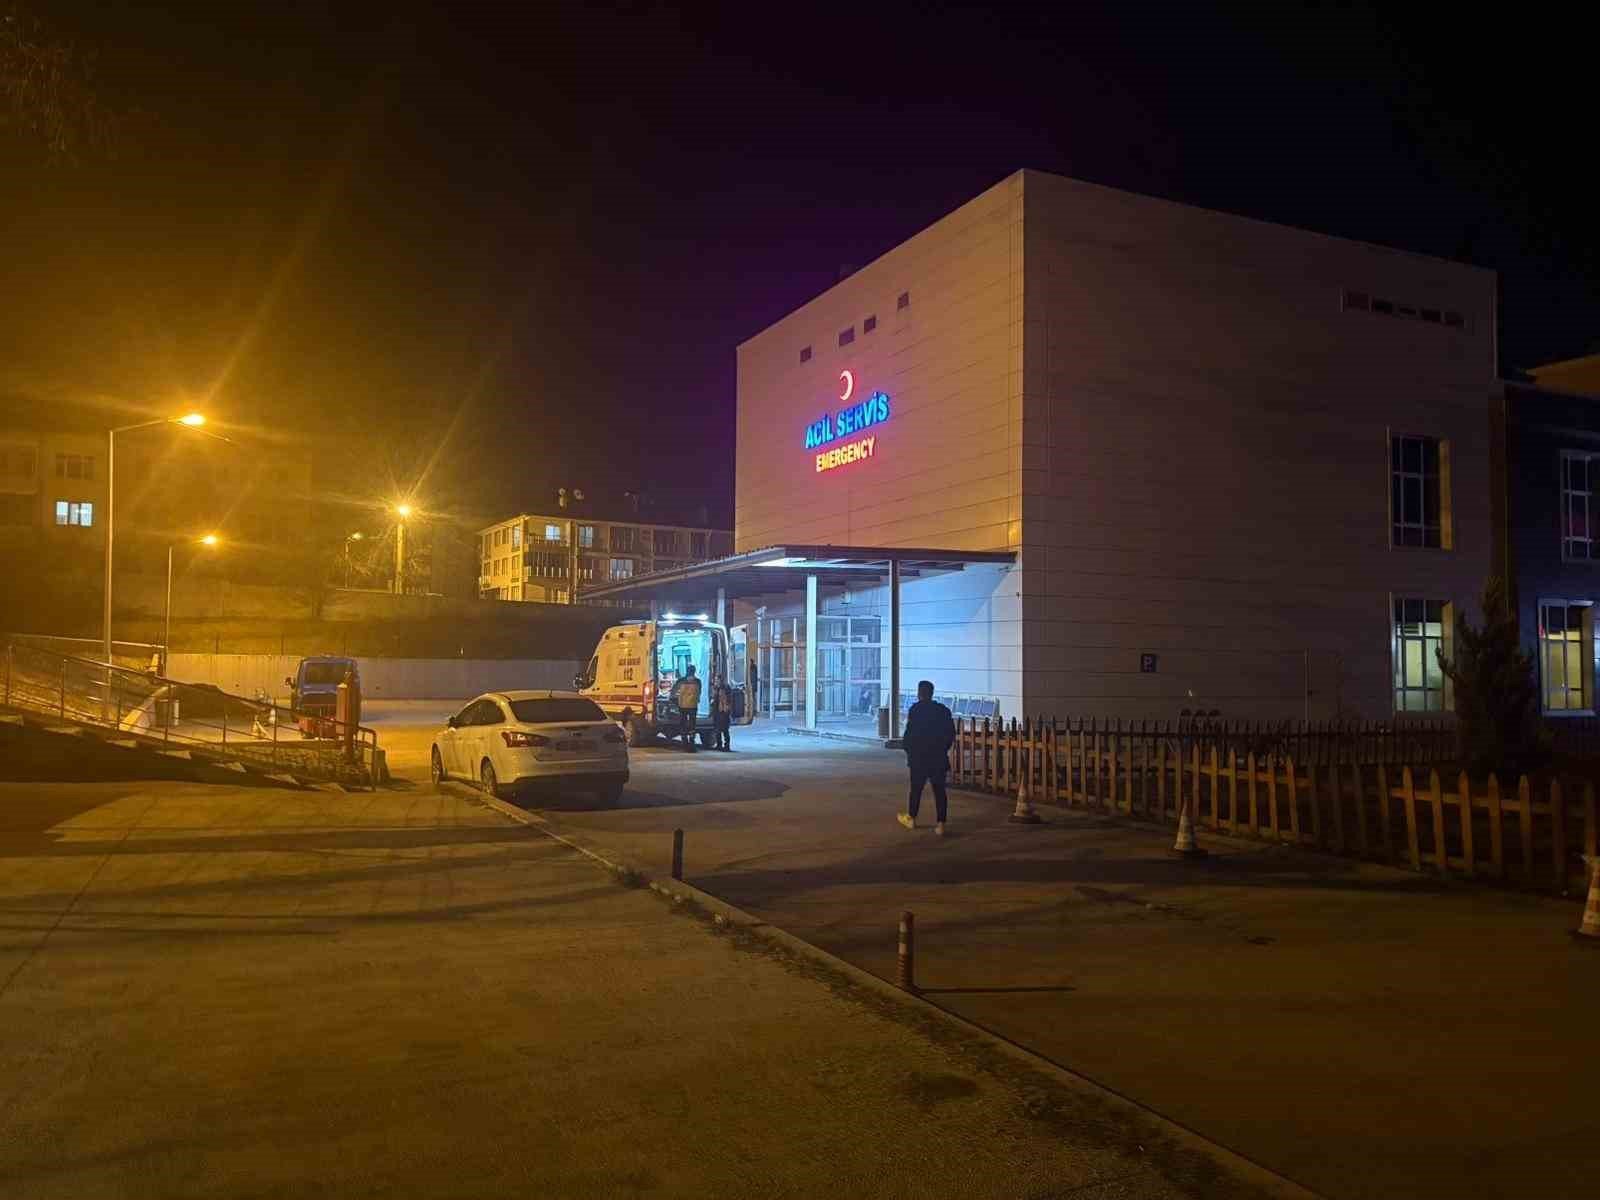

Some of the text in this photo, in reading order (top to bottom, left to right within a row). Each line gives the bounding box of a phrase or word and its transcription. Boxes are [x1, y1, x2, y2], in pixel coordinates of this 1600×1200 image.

[805, 391, 890, 449] ACİL SERVİS
[815, 436, 876, 472] EMERGENCY
[623, 667, 633, 681] 112
